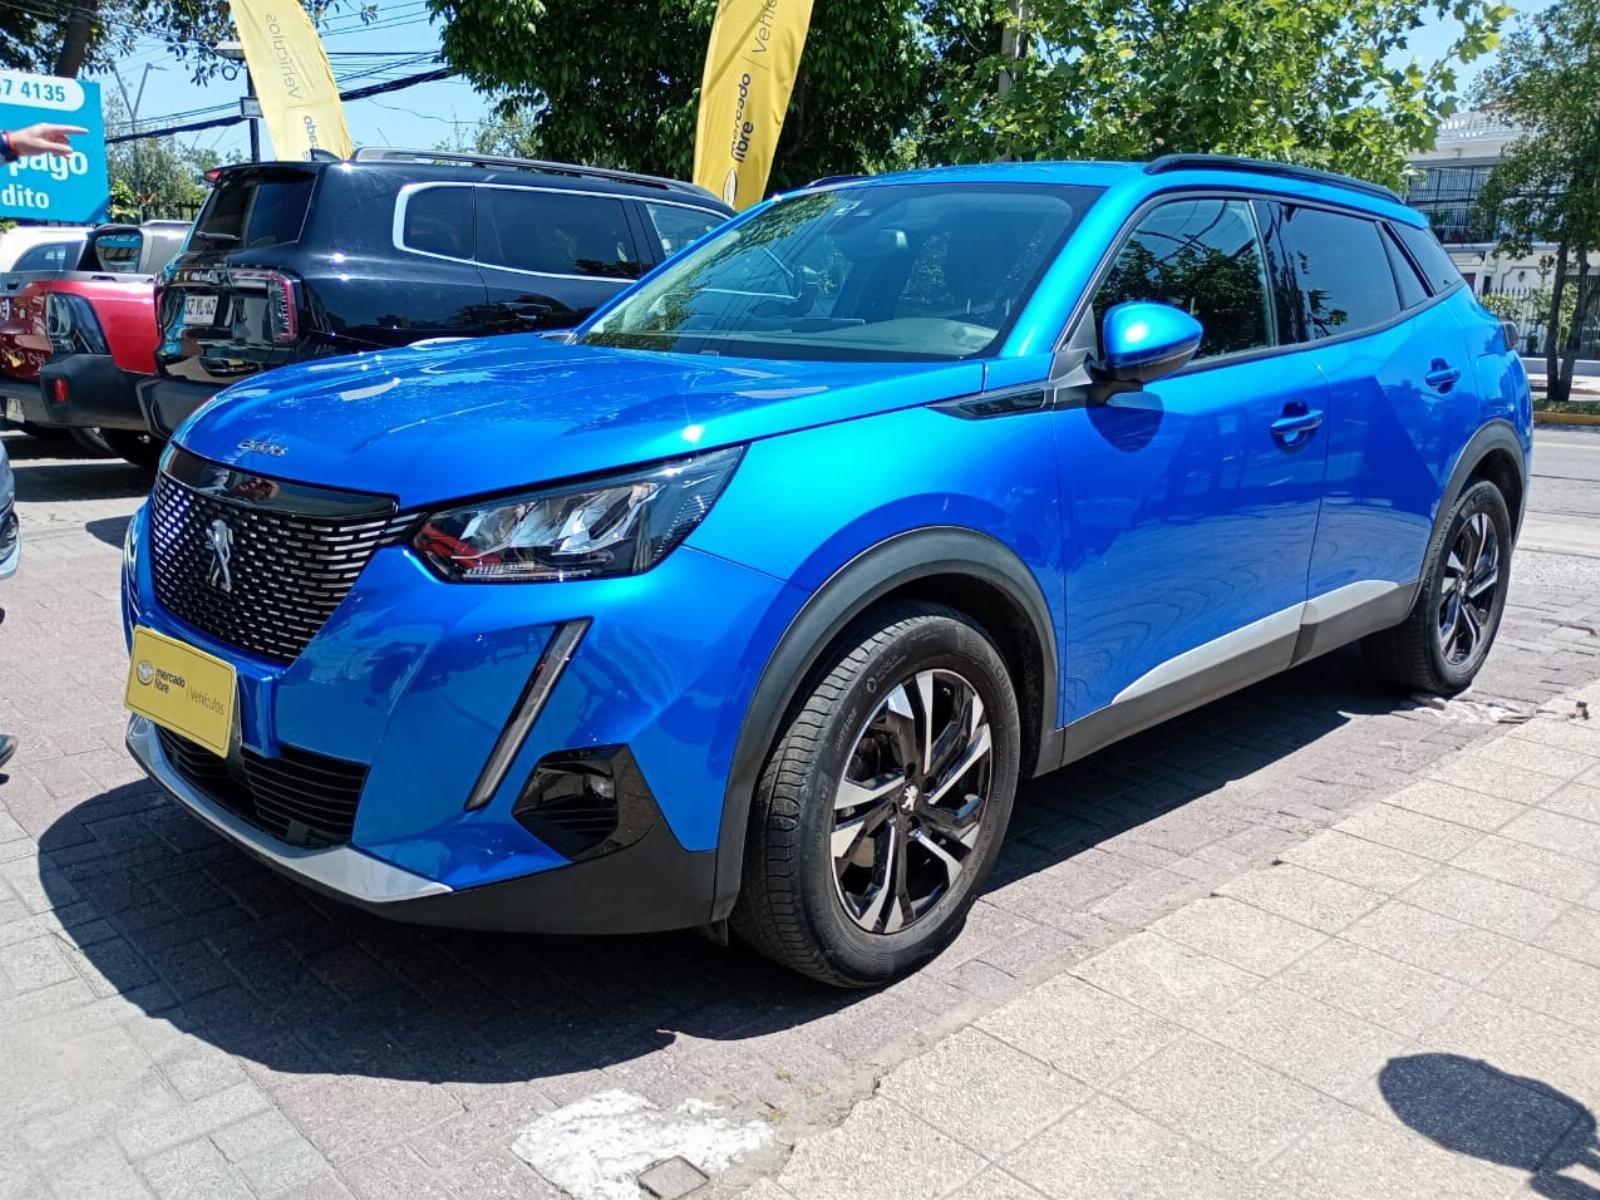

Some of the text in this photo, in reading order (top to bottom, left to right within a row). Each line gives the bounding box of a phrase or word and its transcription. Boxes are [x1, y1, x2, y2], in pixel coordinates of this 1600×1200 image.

[20, 82, 66, 102] 4135
[731, 73, 750, 159] mercado
[735, 121, 753, 163] libre
[9, 151, 88, 181] pago
[1, 183, 49, 209] dito
[155, 668, 185, 688] mercado
